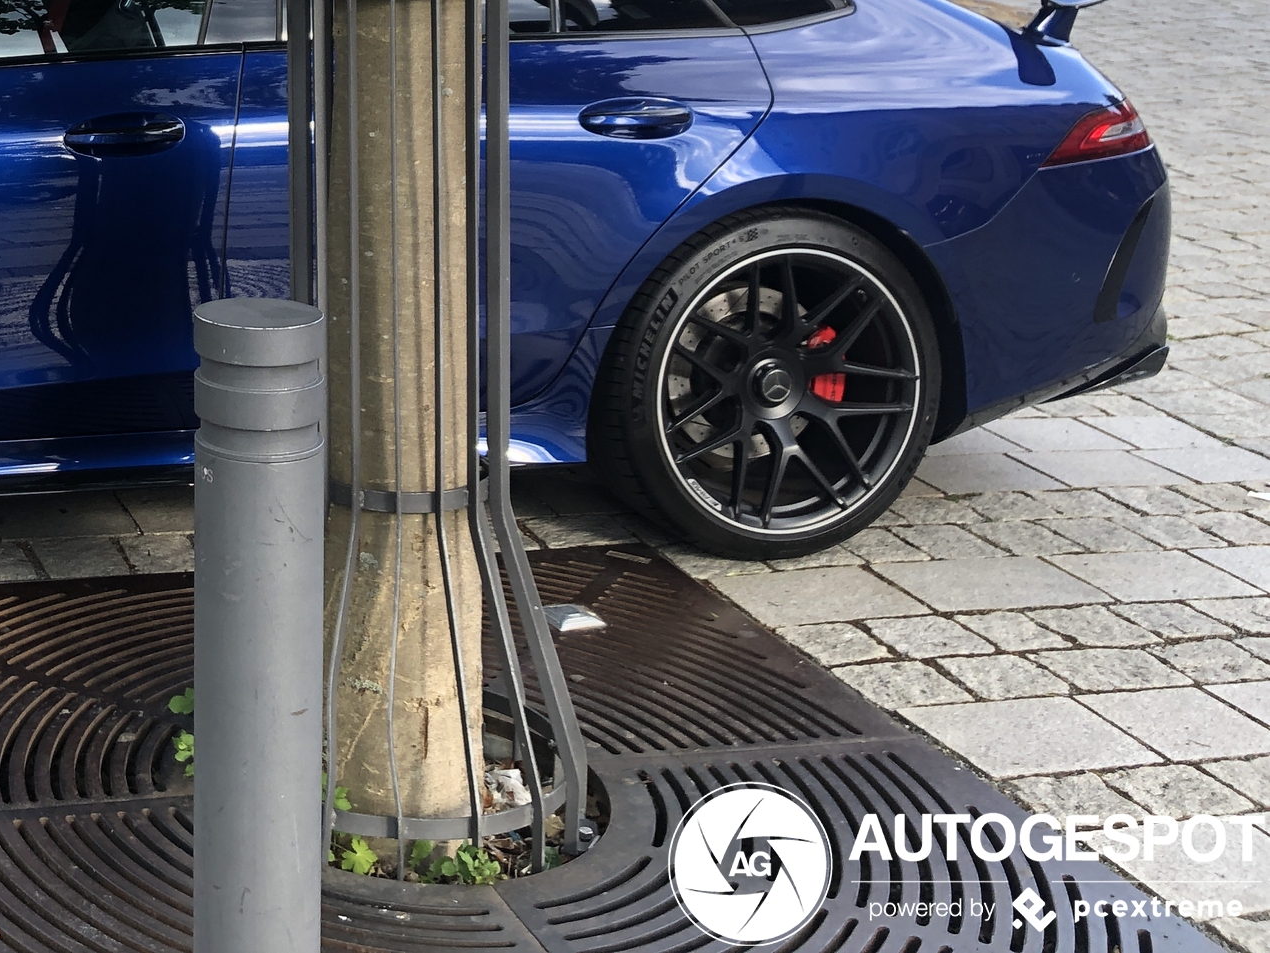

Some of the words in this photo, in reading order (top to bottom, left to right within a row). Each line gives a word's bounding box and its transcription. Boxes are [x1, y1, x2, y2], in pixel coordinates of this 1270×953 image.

[678, 262, 700, 286] PILOT
[703, 241, 731, 263] SPORT
[632, 293, 674, 400] MICHELIN
